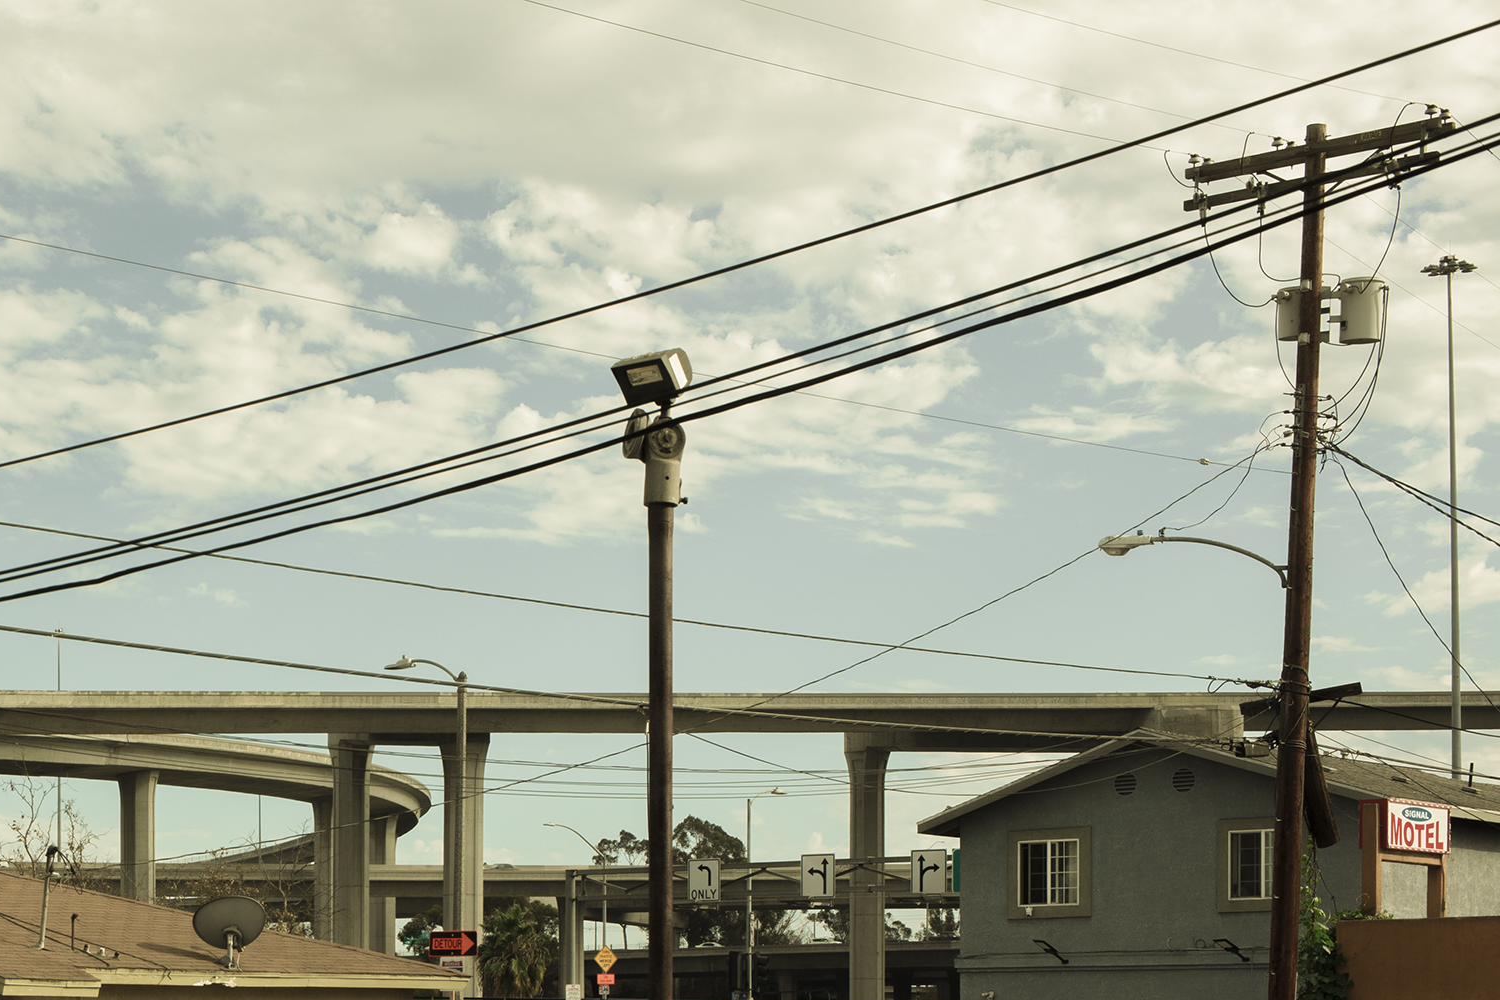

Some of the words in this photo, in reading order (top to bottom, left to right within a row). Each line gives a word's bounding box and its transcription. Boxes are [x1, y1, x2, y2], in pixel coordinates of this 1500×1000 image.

[1404, 809, 1430, 820] SIGNAL
[1390, 811, 1444, 850] MOTEL
[691, 889, 717, 900] ONLY
[434, 939, 463, 949] DETOUR
